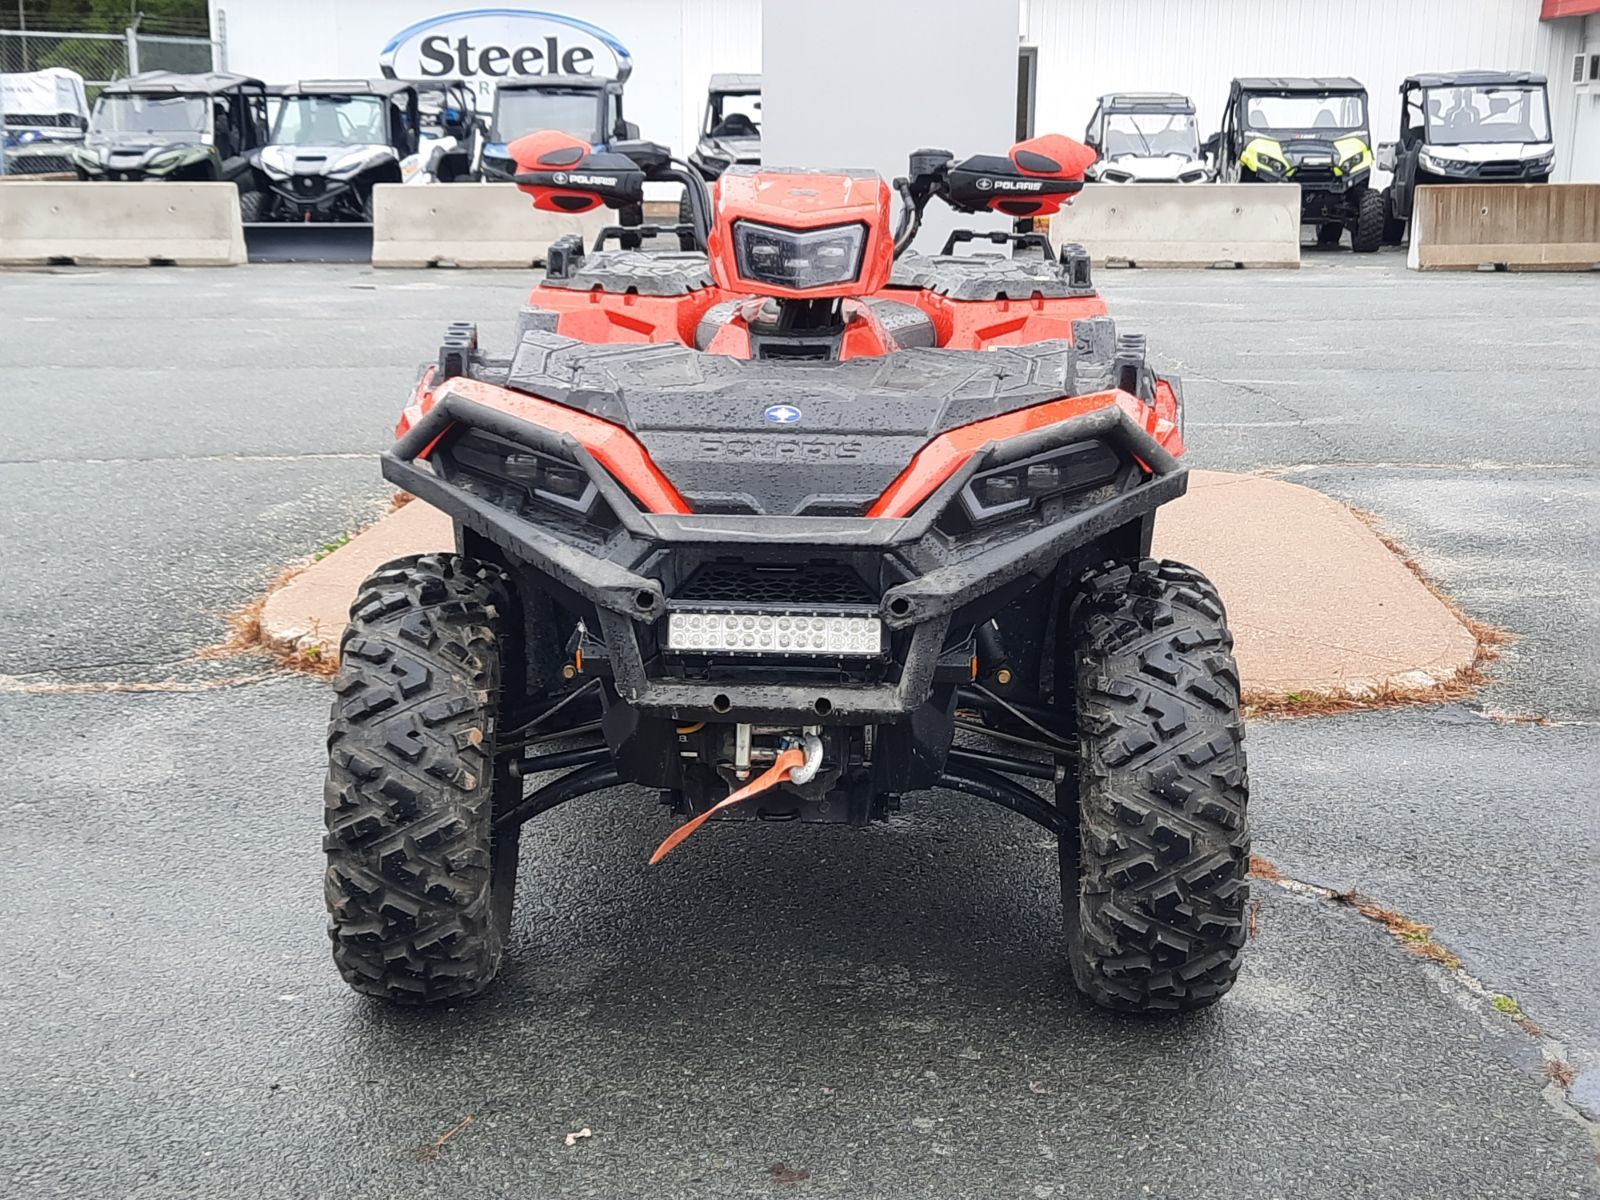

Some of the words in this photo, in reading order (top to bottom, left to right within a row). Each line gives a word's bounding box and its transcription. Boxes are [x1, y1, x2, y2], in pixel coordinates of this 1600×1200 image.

[420, 36, 594, 76] Steele
[569, 176, 618, 186] POLARIS
[994, 180, 1043, 191] POLARIS
